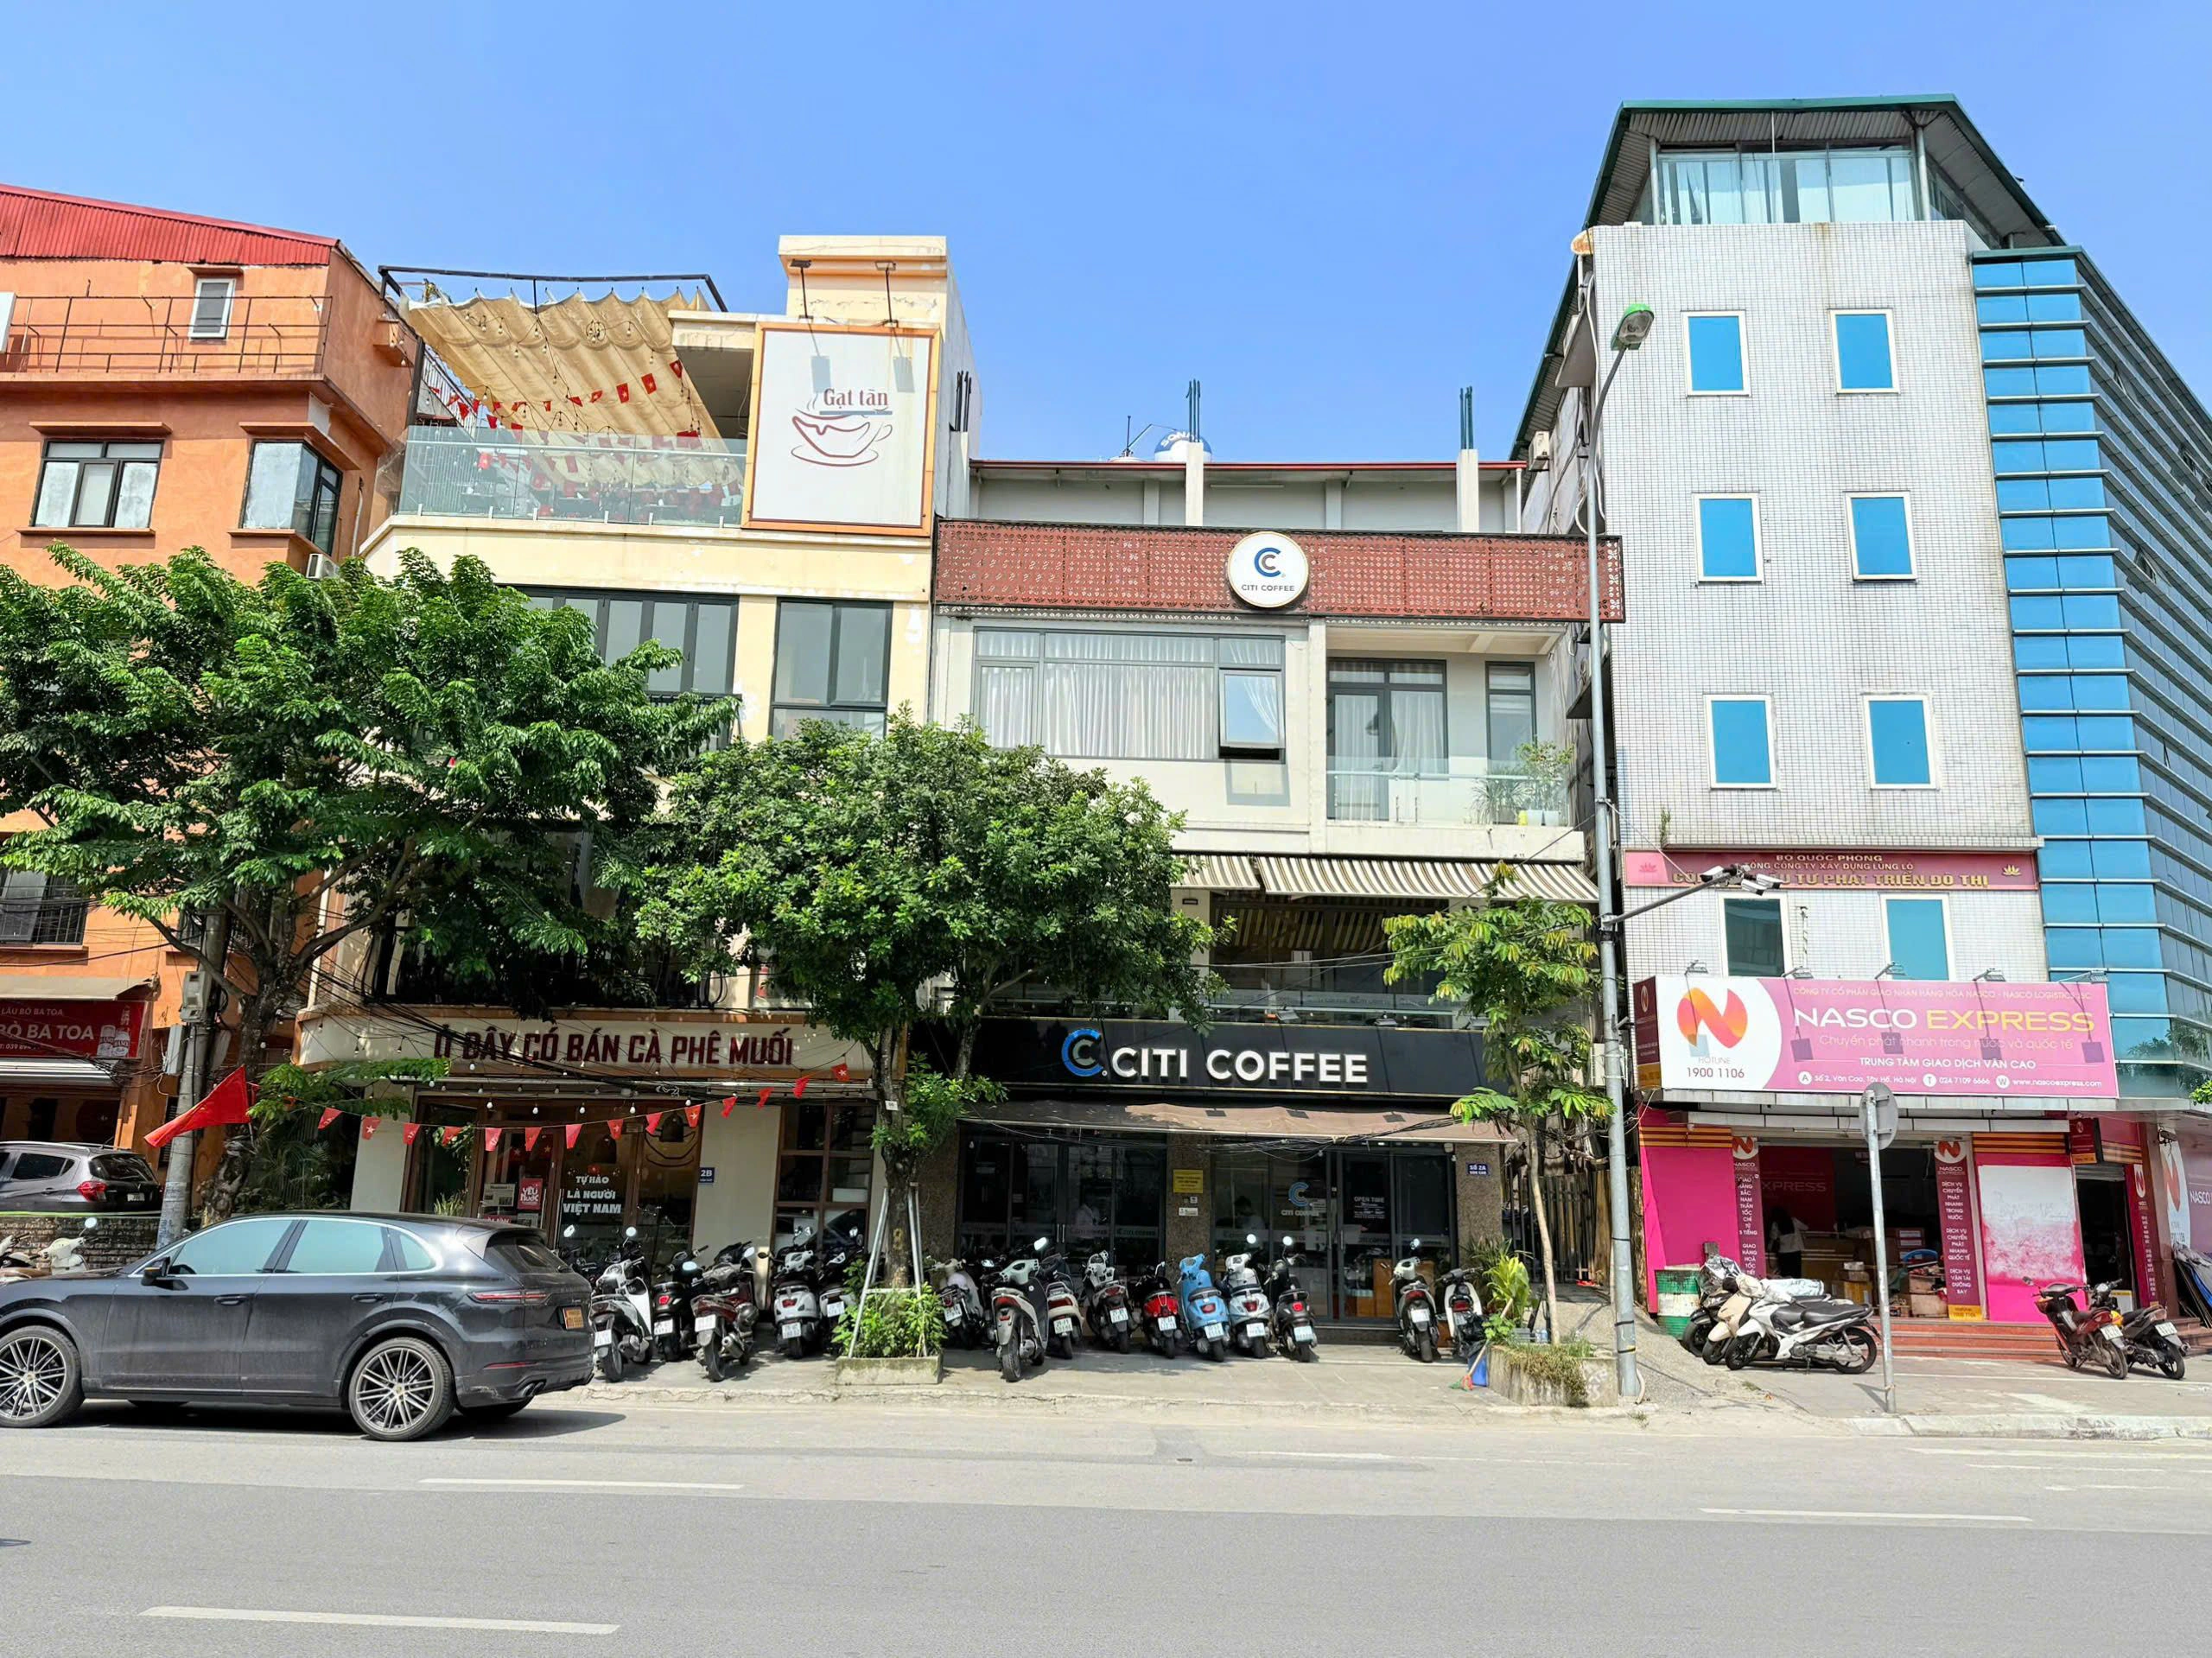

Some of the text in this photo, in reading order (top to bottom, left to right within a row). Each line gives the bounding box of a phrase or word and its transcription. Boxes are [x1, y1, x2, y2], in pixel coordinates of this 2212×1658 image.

[823, 388, 854, 409] Gạt
[1794, 1007, 2094, 1032] NASCO EXPRESS
[27, 1024, 52, 1039] BA
[56, 1025, 94, 1040] TOA
[523, 1026, 559, 1061] CÓ
[566, 1027, 621, 1063] BÁN
[627, 1028, 661, 1064] CÀ
[671, 1029, 721, 1064] PHÊ
[728, 1027, 793, 1065] MUỐI
[1112, 1046, 1368, 1083] CITI COFFEE
[1698, 1056, 1732, 1064] HOTLINE
[1859, 1057, 1895, 1067] TRUNG
[1897, 1056, 1920, 1068] TÂM
[1923, 1058, 1952, 1068] GIAO
[2010, 1059, 2037, 1070] CAO
[1688, 1067, 1745, 1078] 1900 1106
[567, 1188, 581, 1200] LÀ
[563, 1200, 621, 1216] VIỆT NAM
